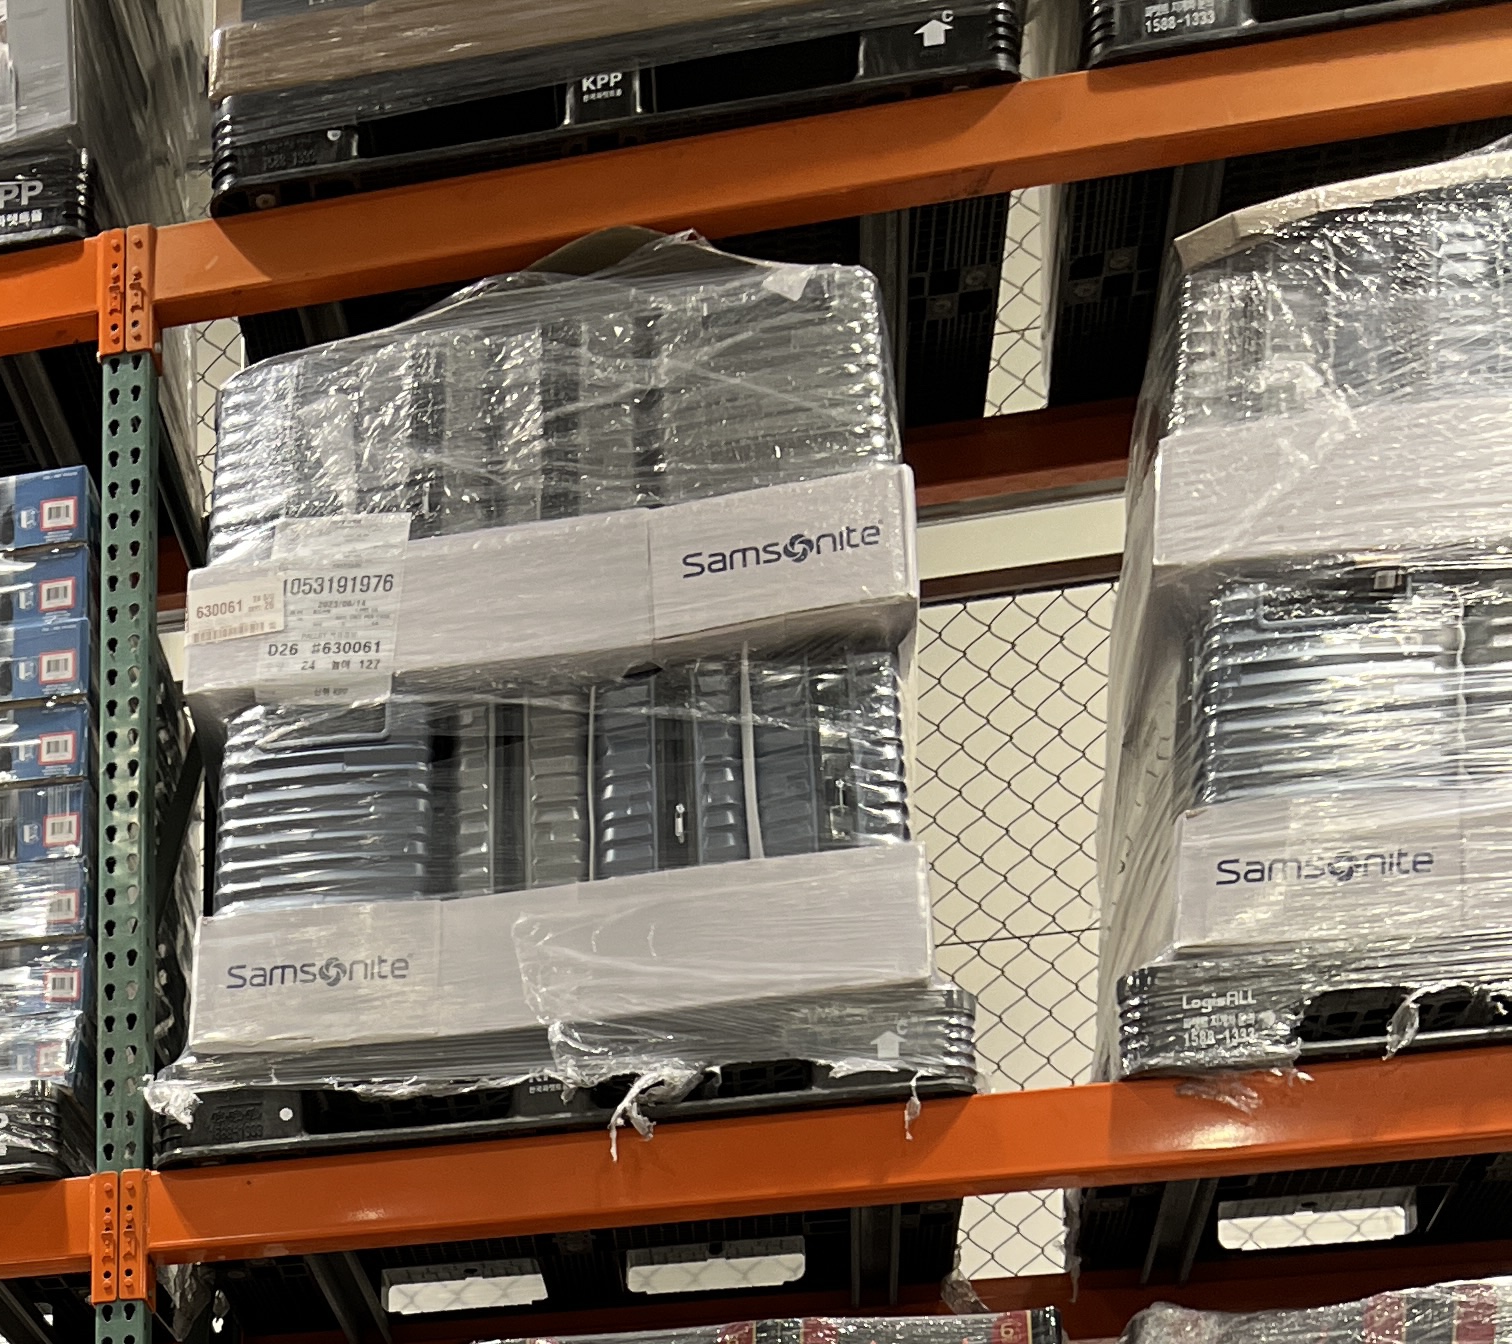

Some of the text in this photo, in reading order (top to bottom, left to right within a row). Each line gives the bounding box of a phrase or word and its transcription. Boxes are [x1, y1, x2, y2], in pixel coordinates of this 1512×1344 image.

[582, 71, 623, 91] KPP
[682, 523, 880, 579] Samsonite
[197, 601, 242, 619] 630061
[268, 641, 381, 656] D26 #630061
[1216, 849, 1432, 886] Samsonite
[226, 955, 409, 991] Samsonite
